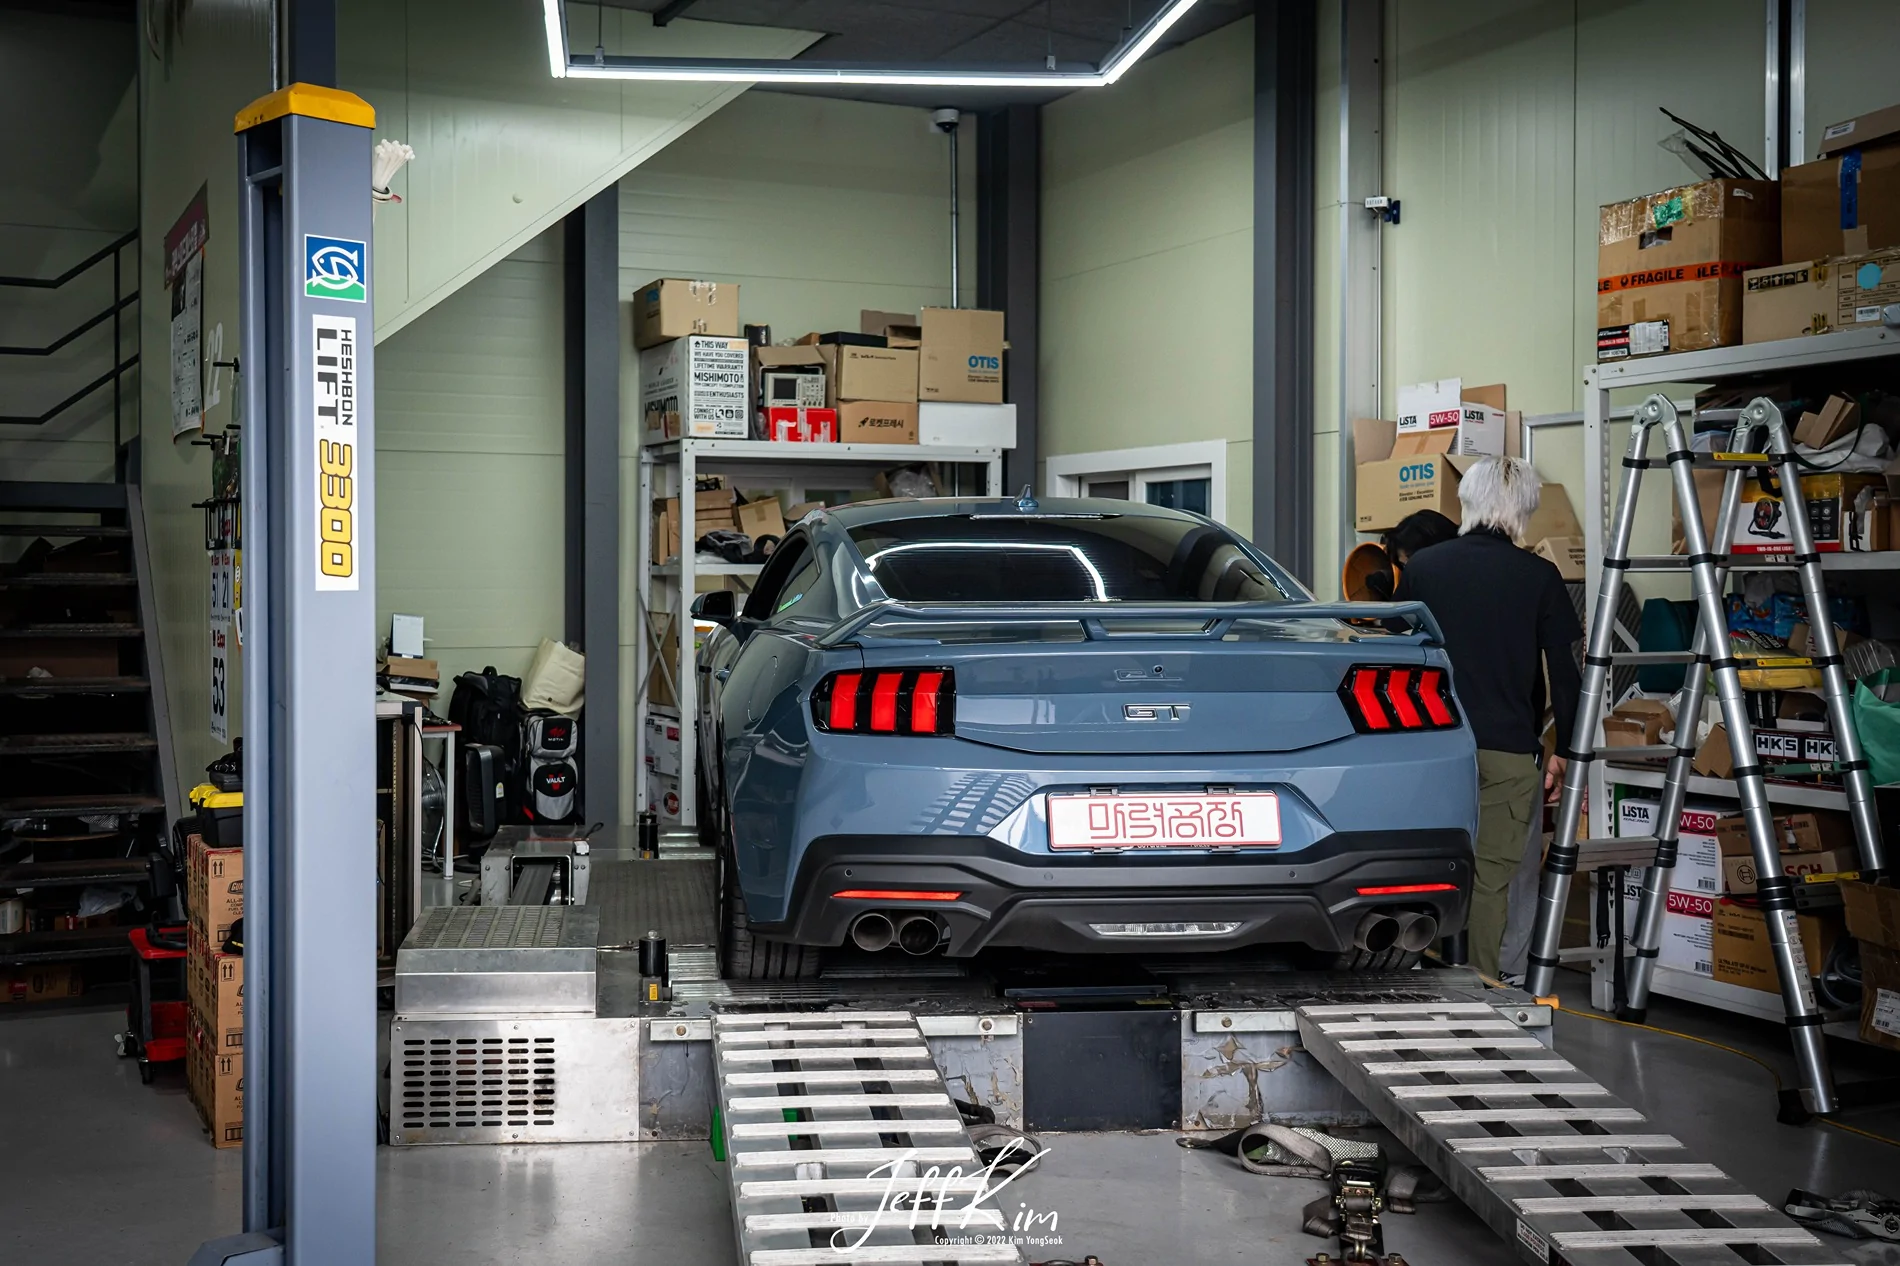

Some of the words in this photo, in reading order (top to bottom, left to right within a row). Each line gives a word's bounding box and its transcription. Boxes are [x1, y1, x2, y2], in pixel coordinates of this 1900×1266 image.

[1630, 268, 1684, 286] FRAGILE
[701, 340, 714, 349] THIS
[715, 341, 728, 349] WAY
[694, 362, 715, 370] LIFETIME
[968, 355, 999, 369] OTIS
[316, 328, 338, 425] LIFT
[341, 329, 353, 425] HESHBON
[694, 372, 740, 383] MISHIMOTO
[709, 390, 744, 399] ENTHUSIASTS
[869, 417, 904, 429] 로켓프레시
[1430, 411, 1459, 425] 5W-50
[1399, 462, 1435, 482] OTIS
[319, 439, 353, 578] 3300
[212, 657, 225, 717] 53
[1122, 703, 1192, 721] GT
[1757, 736, 1797, 751] HKS
[546, 776, 566, 784] VAULT
[1680, 814, 1714, 830] W-50
[1669, 894, 1713, 913] 5W-50
